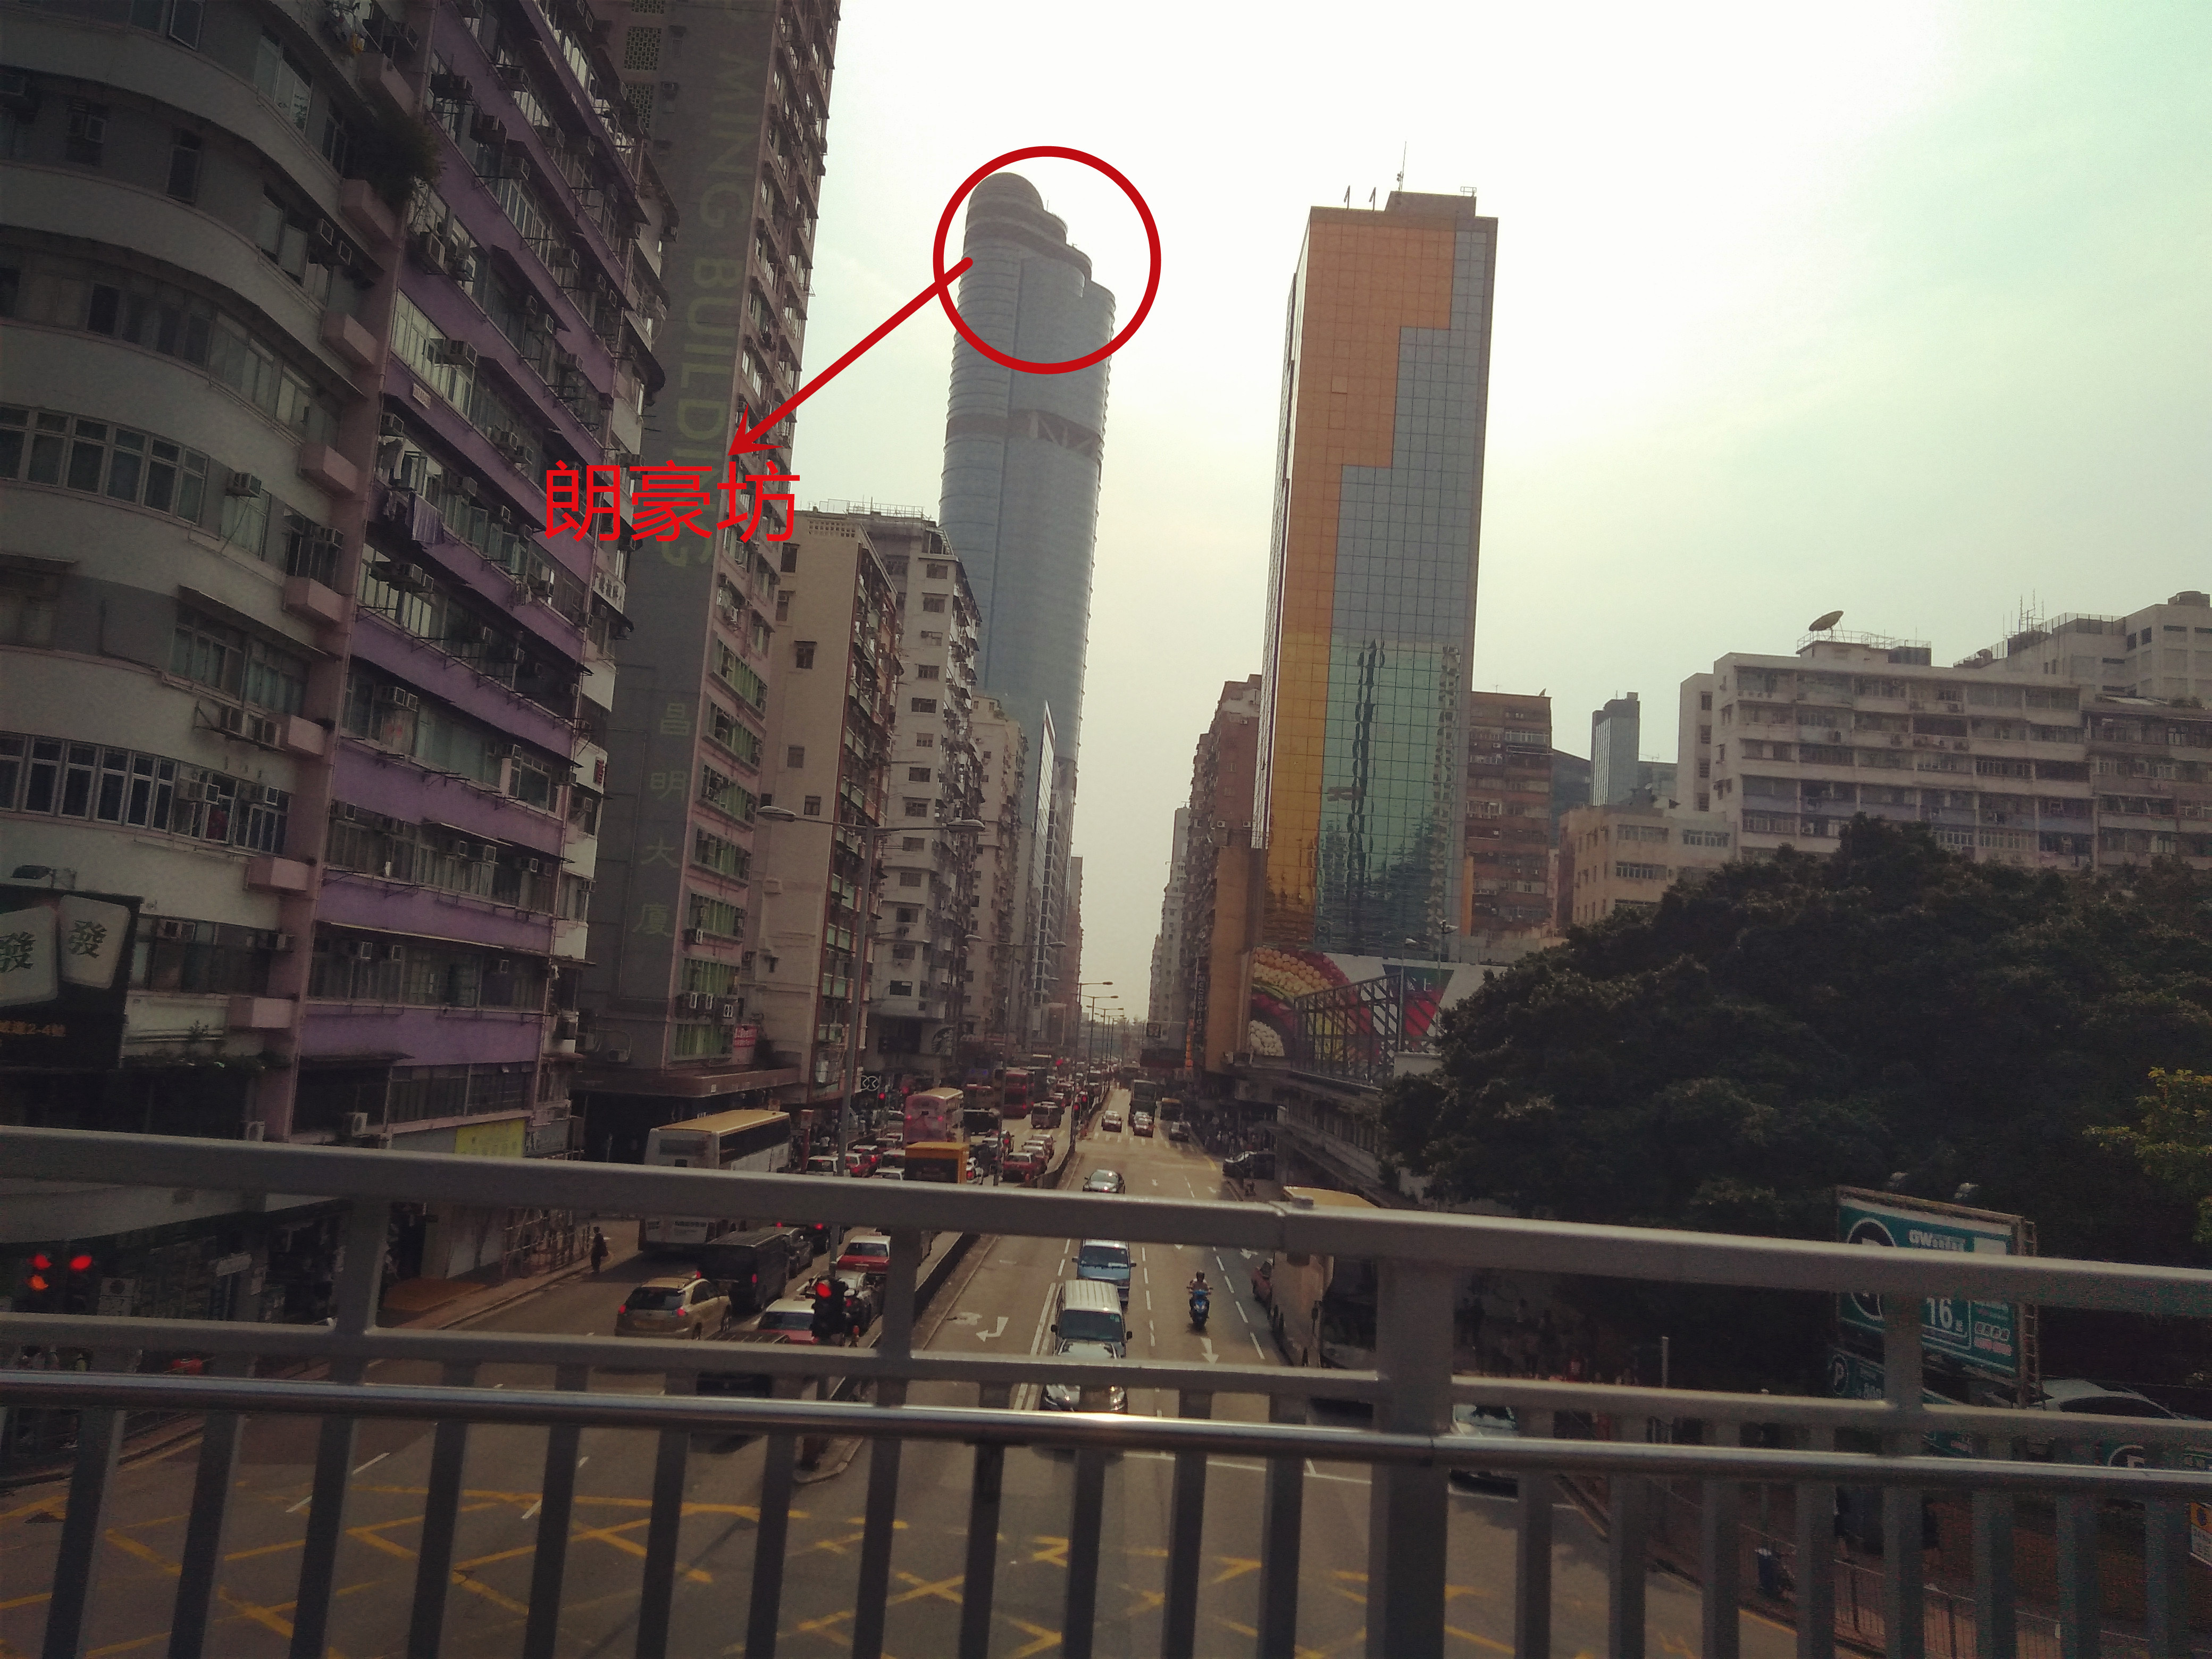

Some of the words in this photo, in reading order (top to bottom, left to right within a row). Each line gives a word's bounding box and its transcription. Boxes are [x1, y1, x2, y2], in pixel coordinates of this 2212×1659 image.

[700, 53, 765, 228] MING
[632, 702, 690, 937] 昌明大廈
[69, 919, 107, 959] 發
